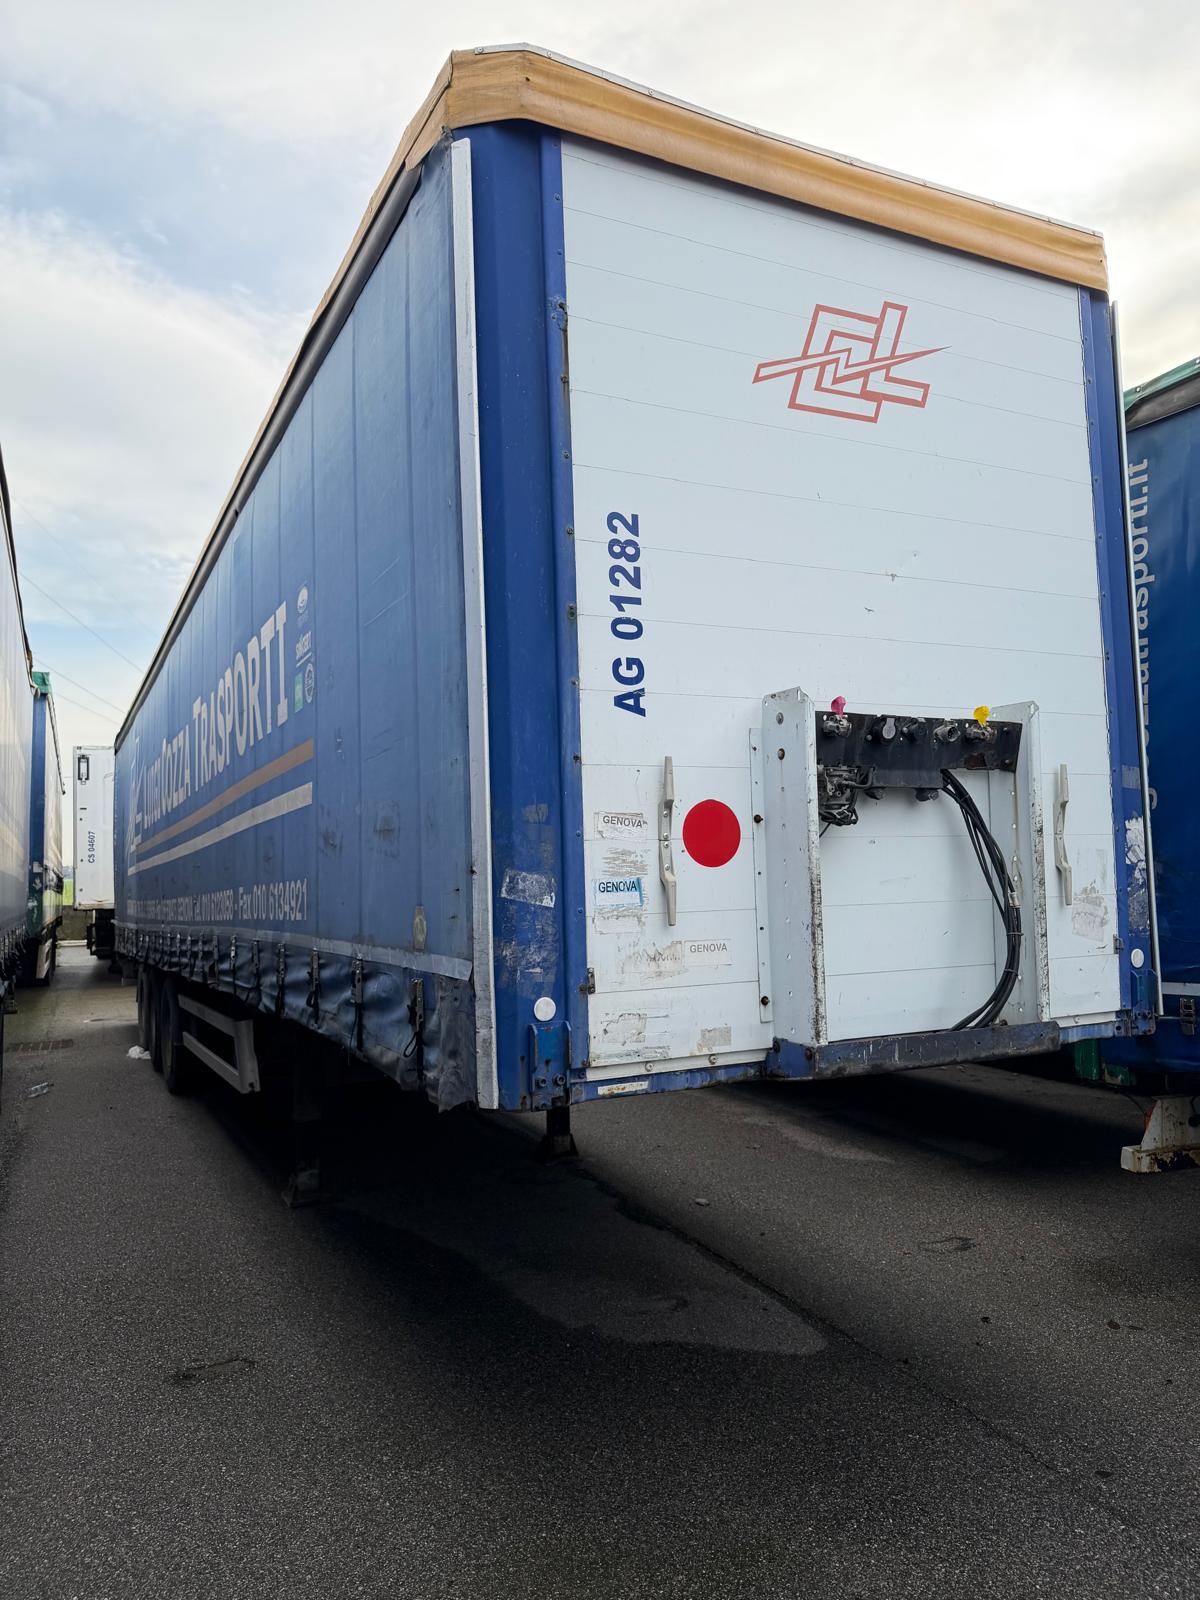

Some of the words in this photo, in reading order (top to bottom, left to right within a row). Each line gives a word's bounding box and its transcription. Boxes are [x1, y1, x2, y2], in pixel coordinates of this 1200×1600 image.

[606, 511, 643, 640] 01282
[612, 656, 646, 717] AG
[161, 724, 191, 816] COZZA
[193, 600, 288, 792] TRASPORTI
[602, 815, 643, 829] GENOVA
[88, 853, 95, 863] CS
[238, 886, 252, 920] Fax
[252, 883, 267, 920] 010
[269, 877, 308, 921] 6134921
[598, 881, 638, 893] GENOVA
[689, 943, 728, 953] GENOVA
